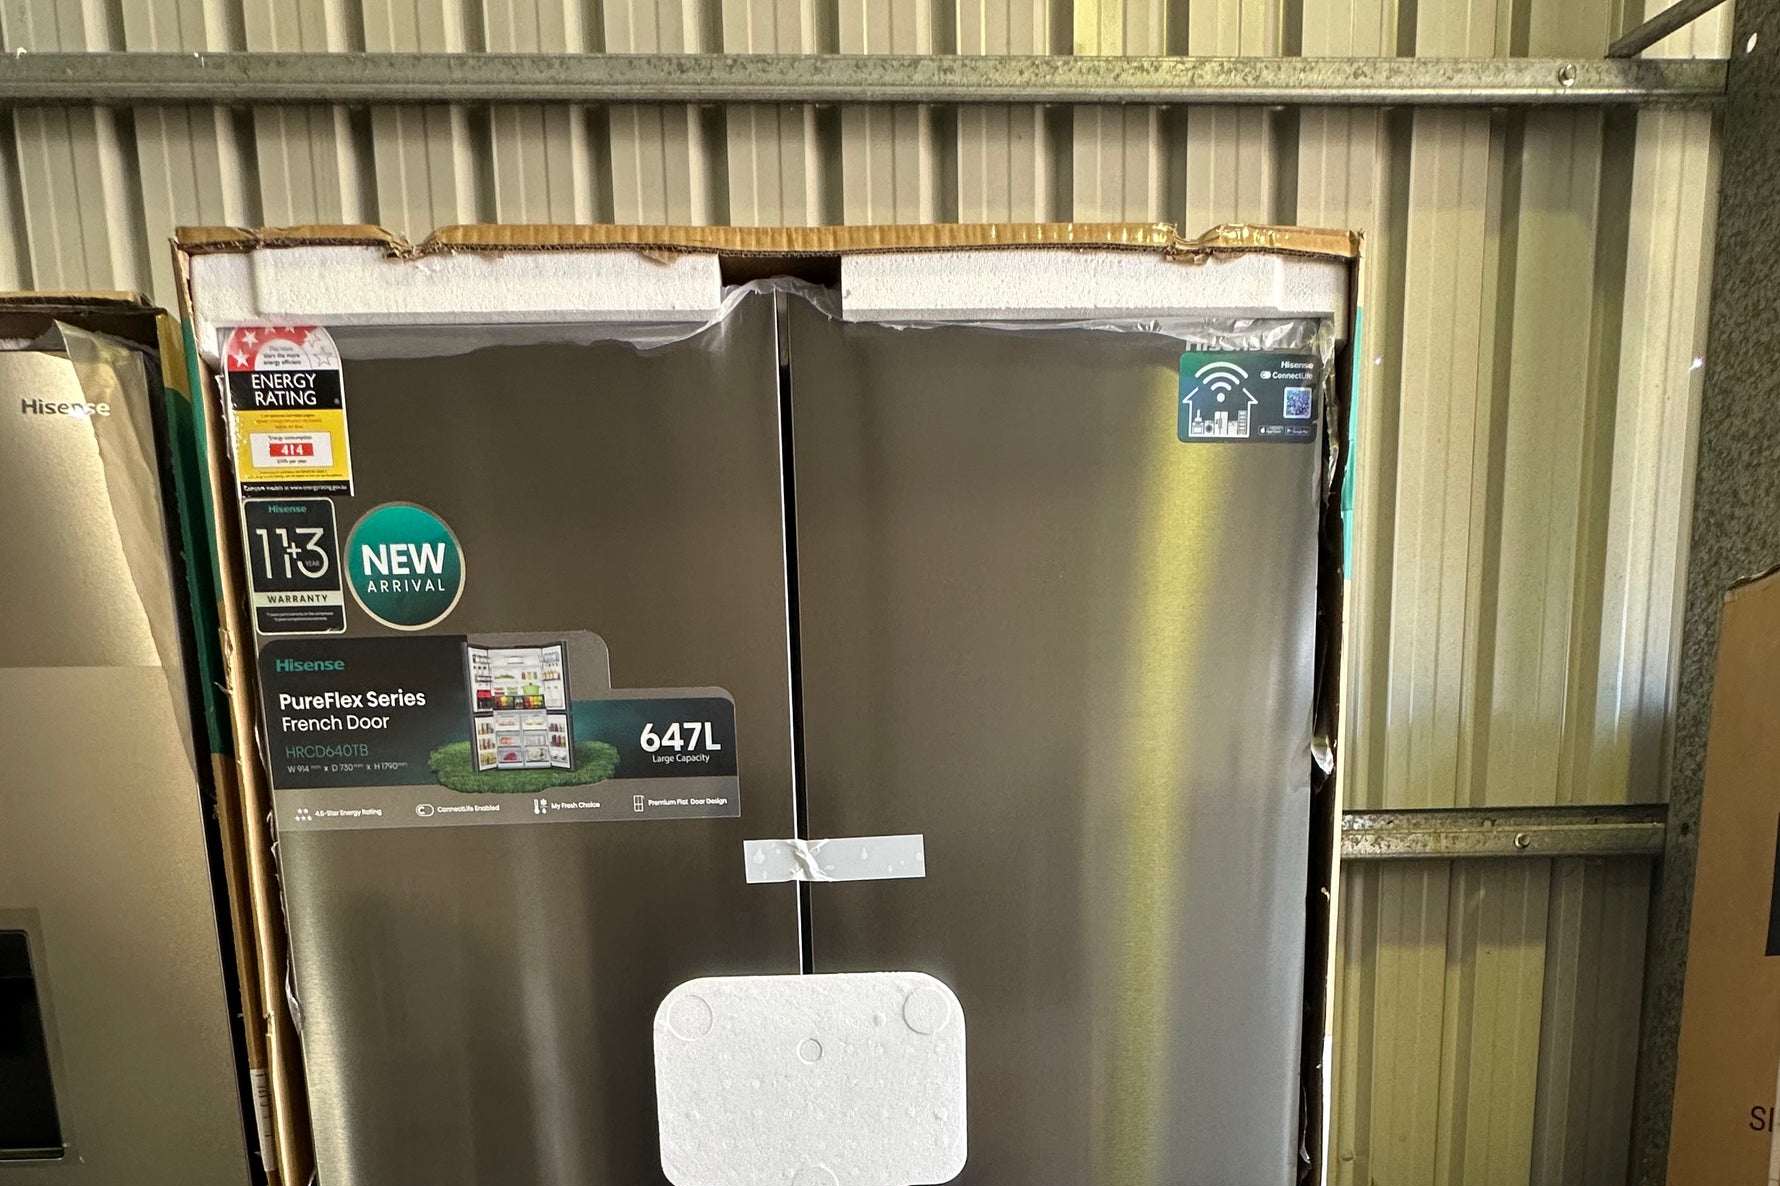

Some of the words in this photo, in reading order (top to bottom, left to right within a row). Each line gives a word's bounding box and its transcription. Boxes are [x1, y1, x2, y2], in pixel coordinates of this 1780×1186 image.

[1280, 361, 1314, 369] Hisense
[252, 373, 317, 389] ENERGY
[1272, 371, 1314, 380] ConnectLife
[255, 390, 317, 406] RATING
[281, 444, 304, 455] 414
[268, 505, 307, 513] Hisense
[361, 543, 446, 576] NEW
[367, 578, 446, 593] ARRIVAL
[267, 594, 328, 603] WARRANTY
[275, 659, 345, 672] Hisense
[279, 692, 363, 710] PureFlex
[366, 689, 426, 708] Series
[282, 714, 342, 732] French
[346, 714, 390, 730] Door
[640, 721, 721, 752] 647L
[285, 743, 369, 759] HRCD640TB
[652, 753, 675, 764] Large
[676, 753, 710, 764] Capacity
[332, 764, 338, 772] D
[374, 763, 380, 771] H
[551, 802, 560, 810] My
[706, 797, 728, 806] Design
